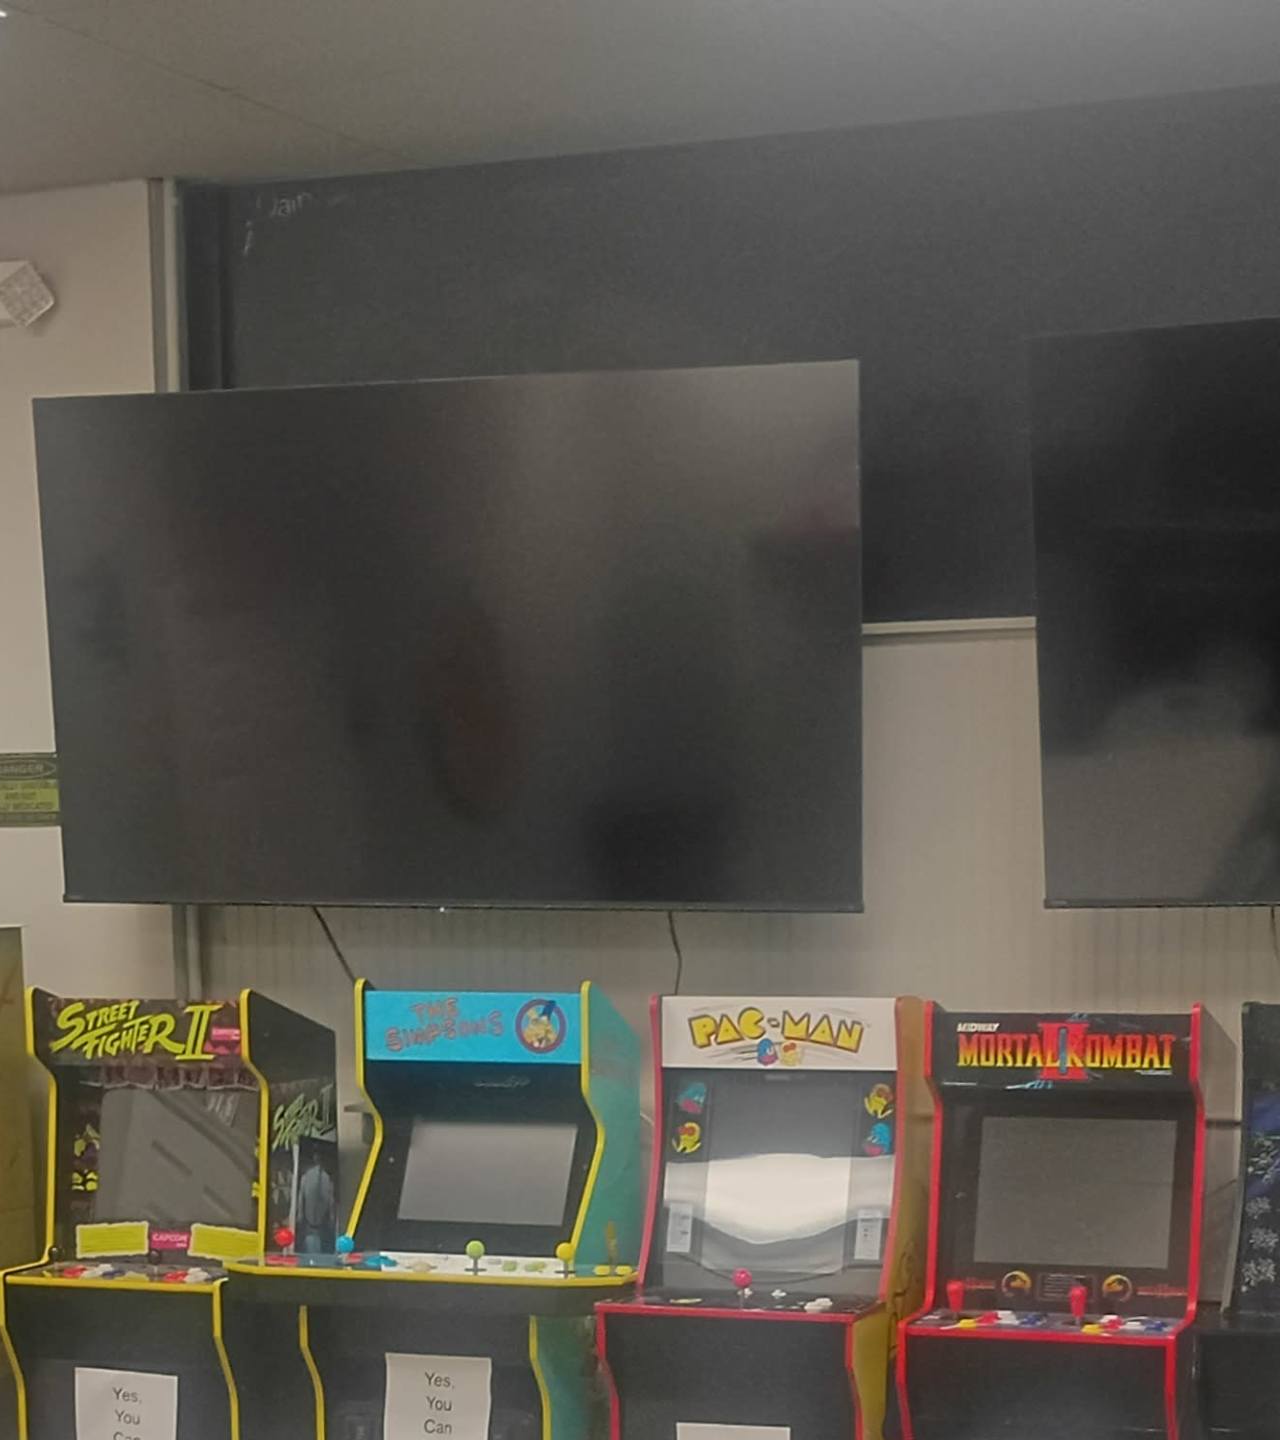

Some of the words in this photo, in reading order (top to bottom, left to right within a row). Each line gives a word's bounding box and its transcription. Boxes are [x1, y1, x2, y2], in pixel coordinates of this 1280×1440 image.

[70, 1013, 186, 1060] FIGHTER
[175, 1003, 223, 1061] II
[688, 1006, 864, 1054] PAC-MAN
[956, 1033, 1062, 1067] MORTAL
[424, 1371, 455, 1389] Yes,
[112, 1386, 142, 1404] Yes,
[425, 1396, 453, 1412] You
[114, 1409, 141, 1425] You
[423, 1418, 453, 1435] Can
